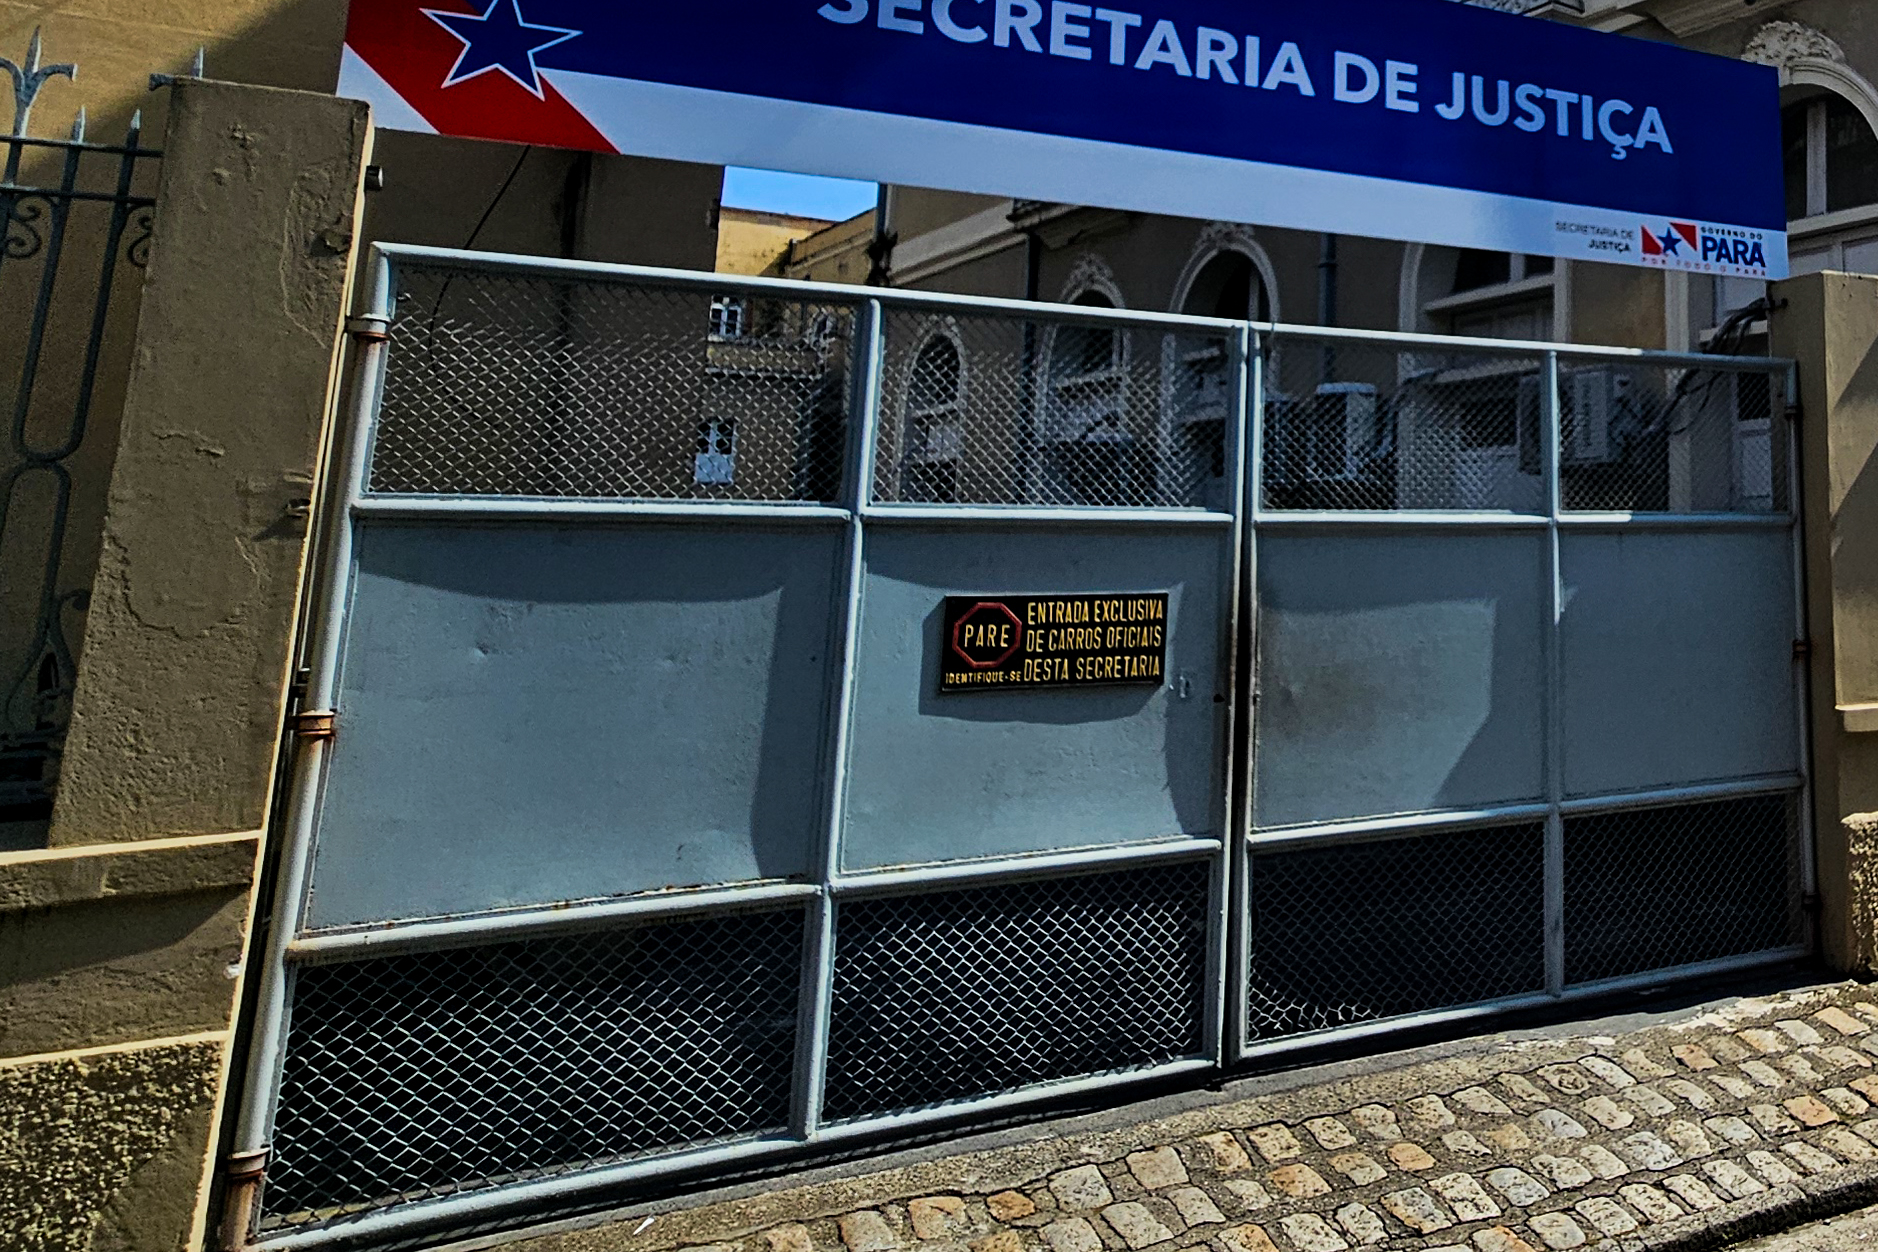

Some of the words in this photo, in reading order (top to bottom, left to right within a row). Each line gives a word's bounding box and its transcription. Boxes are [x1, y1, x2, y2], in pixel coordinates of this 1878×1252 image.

[1334, 50, 1420, 113] DE
[1434, 70, 1673, 160] JUSTIÇA
[1555, 220, 1618, 236] SECRETARIA
[1621, 229, 1634, 241] DE
[1701, 226, 1745, 240] GOVERNO
[1749, 232, 1763, 242] DO
[1588, 239, 1631, 253] JUSTIÇA
[1027, 600, 1089, 625] ENTRADA
[1094, 599, 1164, 622] EXCLUSIVA
[964, 624, 1011, 648] PARE
[1026, 629, 1044, 653] DE
[1048, 627, 1102, 652] CARROS
[1106, 625, 1161, 648] OFICIAIS
[945, 670, 1022, 685] IDENTIFIQUE-SE
[1023, 657, 1069, 682] DESTA
[1075, 655, 1161, 680] SECRETARIA
